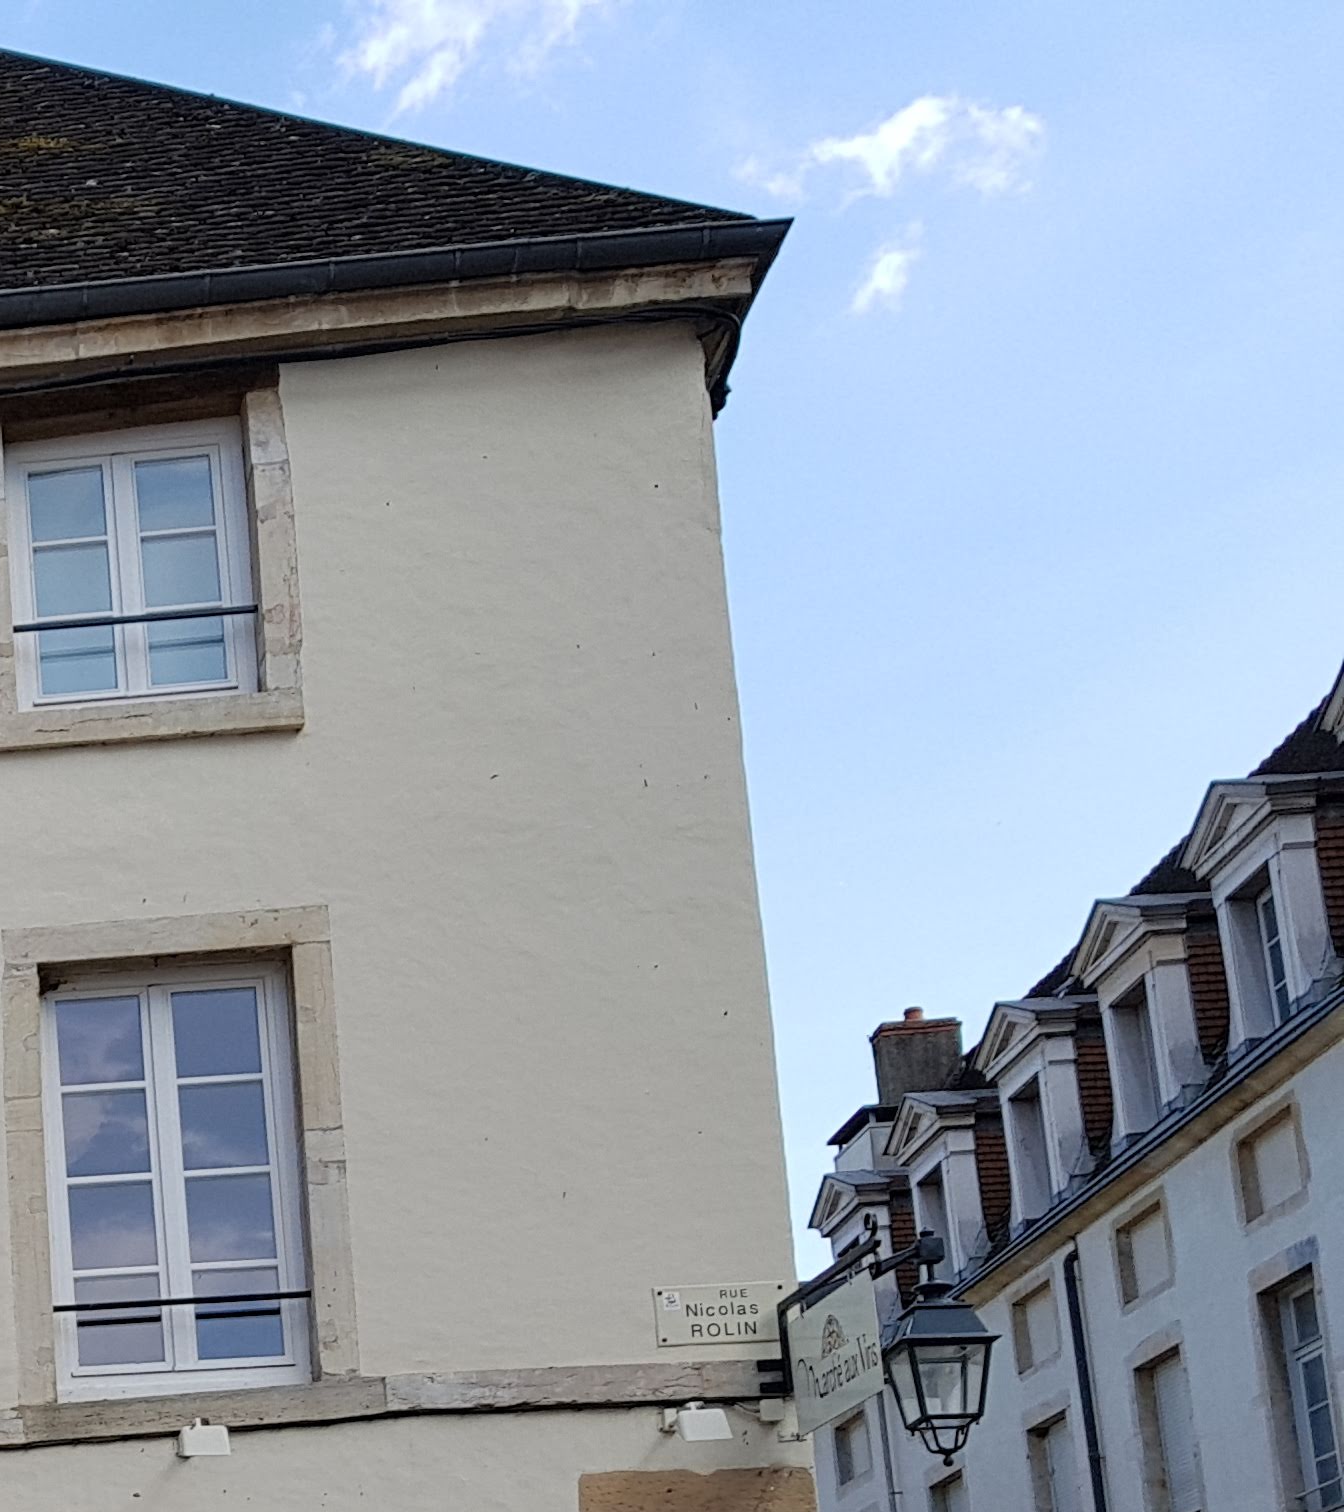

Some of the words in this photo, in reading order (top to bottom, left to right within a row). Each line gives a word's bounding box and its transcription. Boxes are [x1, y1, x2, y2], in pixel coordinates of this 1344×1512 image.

[719, 1288, 748, 1299] RUE
[685, 1301, 760, 1318] Nicolas
[691, 1321, 758, 1338] ROLIN
